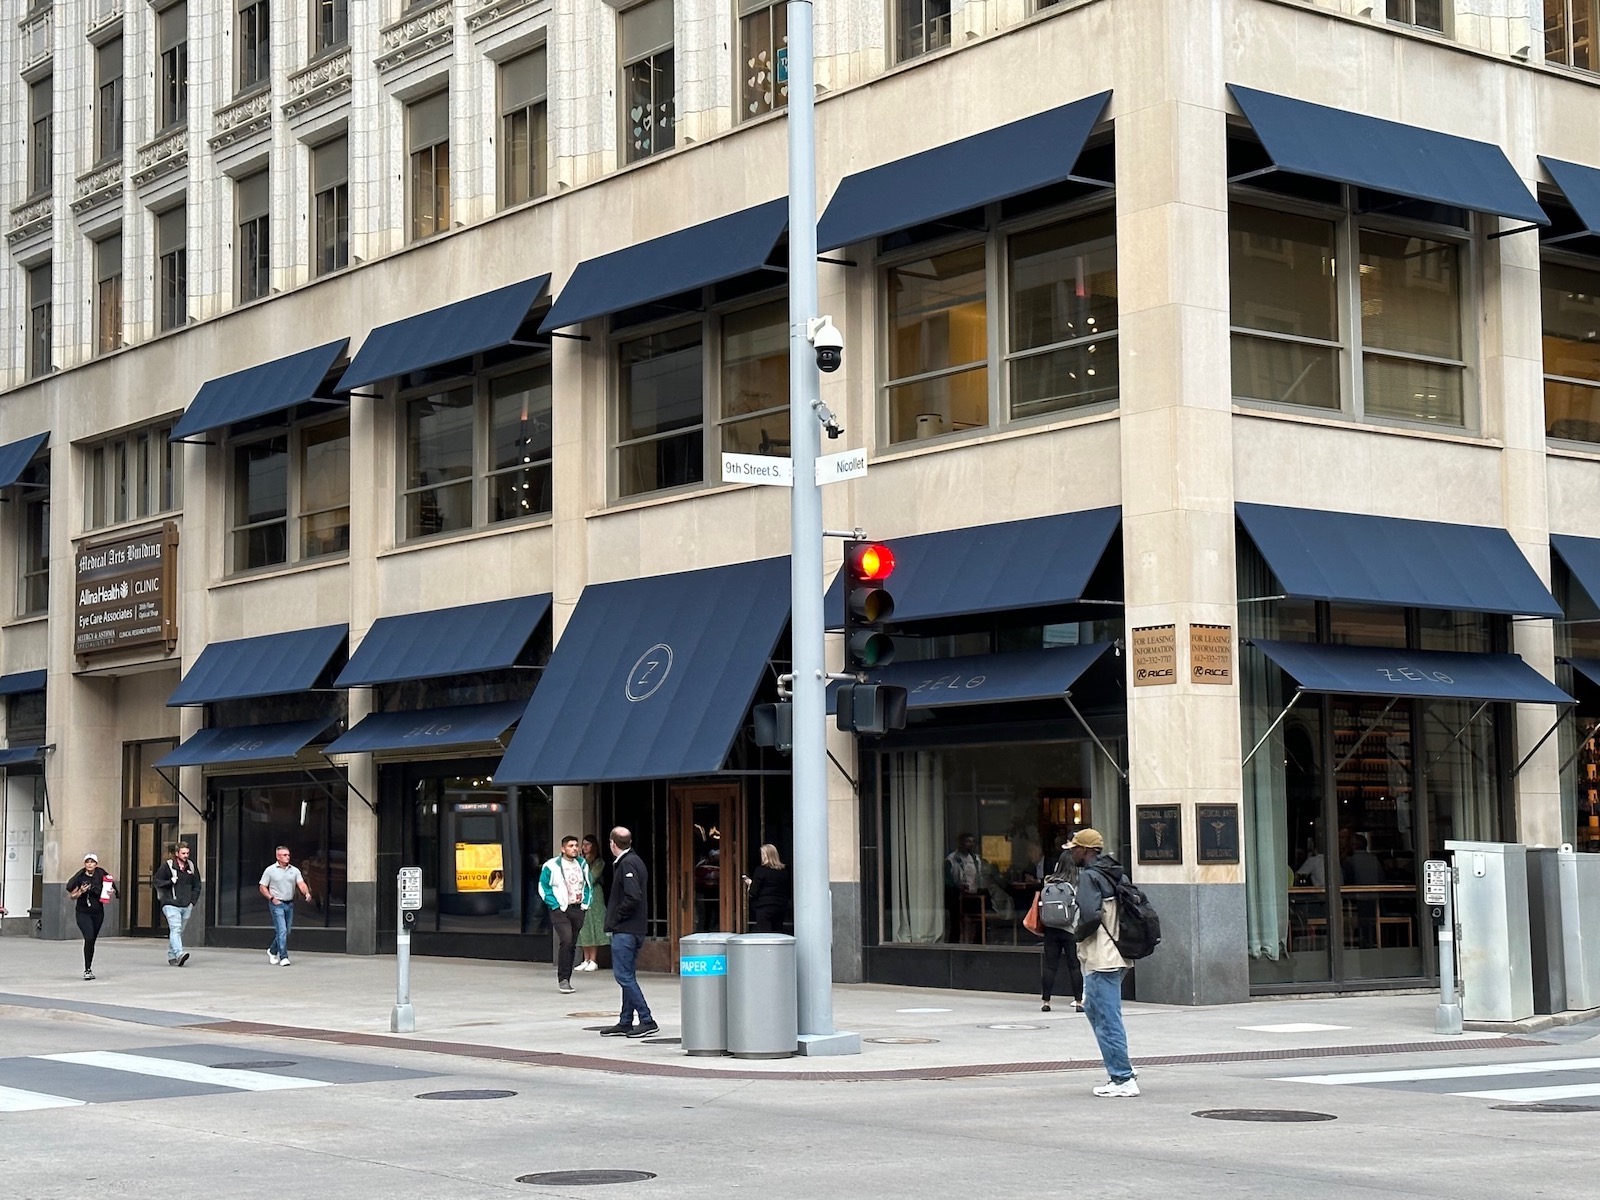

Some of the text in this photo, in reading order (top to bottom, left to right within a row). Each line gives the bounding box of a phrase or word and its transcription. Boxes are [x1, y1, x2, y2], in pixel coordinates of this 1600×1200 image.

[725, 461, 781, 477] 9th Street S.
[836, 457, 864, 474] Nicollet
[79, 543, 161, 573] Medical Arts Building
[135, 577, 159, 594] CLINIC
[79, 608, 133, 629] Eye Care Associates
[77, 632, 94, 642] ALLERGY
[98, 629, 115, 639] ASTHMA
[119, 625, 162, 638] CLINICAL RESEARCH INSTITUTE
[1134, 634, 1174, 646] FOR LEASING
[1191, 634, 1230, 644] FOR LEASING
[1134, 645, 1174, 655] INFORMATION
[1191, 644, 1230, 653] INFORMATION
[1148, 669, 1173, 677] RICE
[1376, 667, 1454, 684] ZELO
[911, 675, 986, 693] ZELO
[1163, 810, 1177, 818] ARTS
[1223, 809, 1236, 818] ARTS
[1144, 849, 1174, 858] BUILDING
[1206, 849, 1232, 858] BUILDING
[681, 961, 707, 972] PAPER
